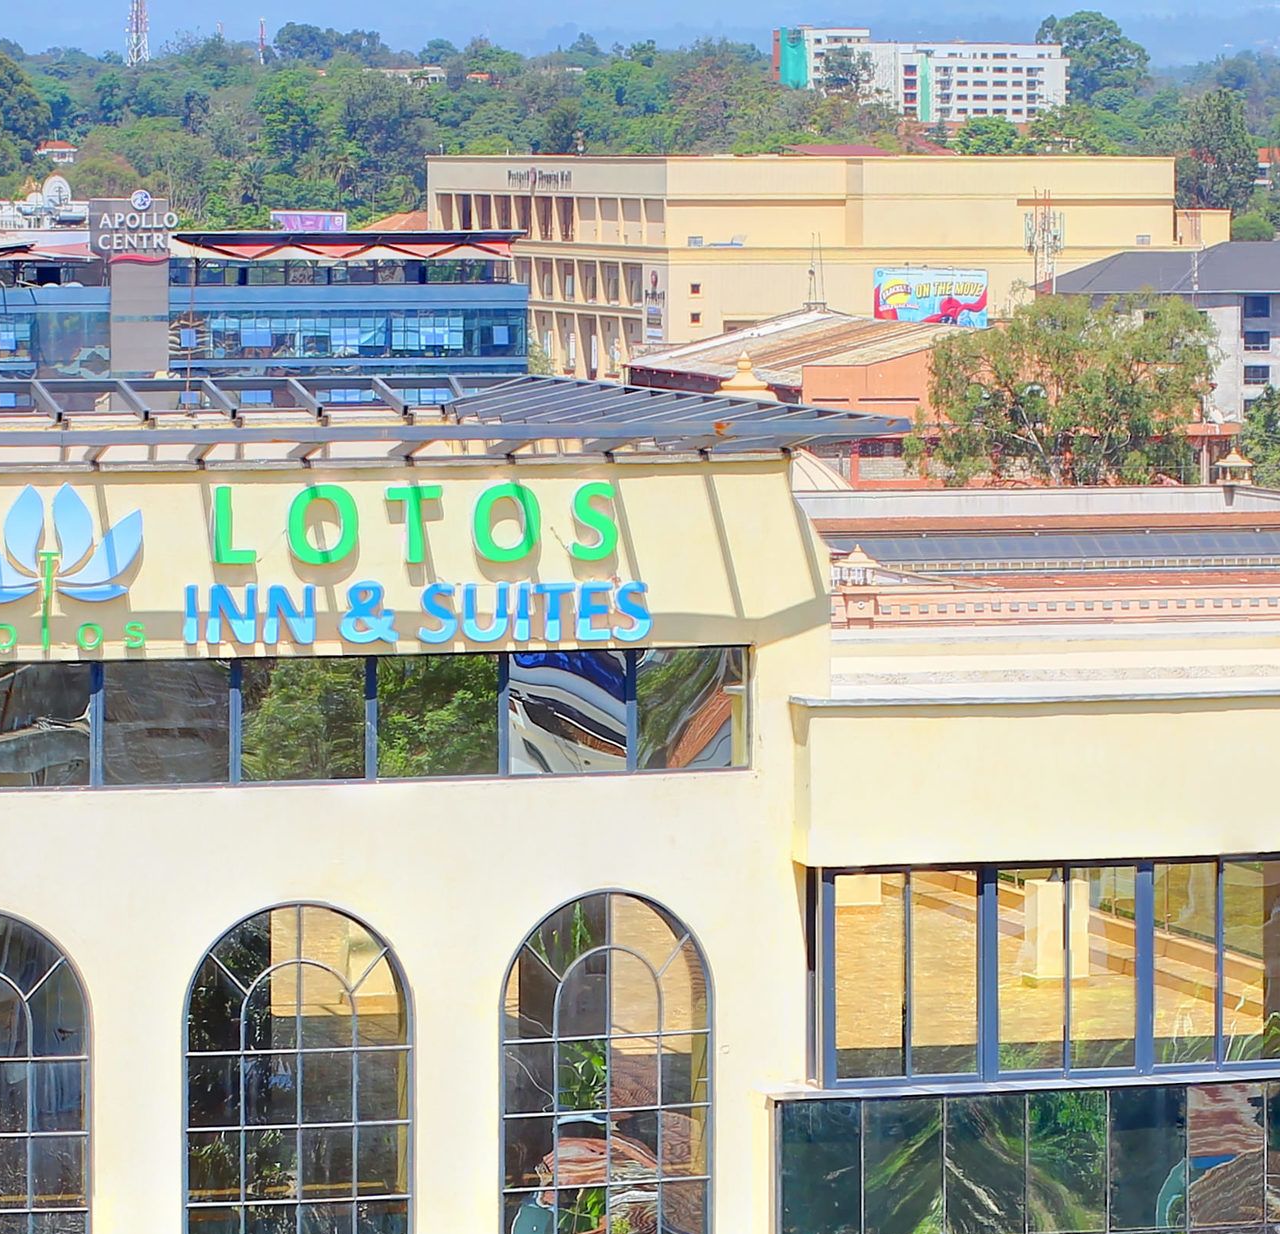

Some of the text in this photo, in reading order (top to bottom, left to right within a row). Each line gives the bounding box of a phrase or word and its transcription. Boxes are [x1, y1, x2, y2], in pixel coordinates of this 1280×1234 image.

[99, 212, 179, 229] APOLLO
[915, 281, 985, 299] ON THE MOVE
[212, 482, 620, 565] LOTOS
[183, 580, 654, 644] INN & SUITES
